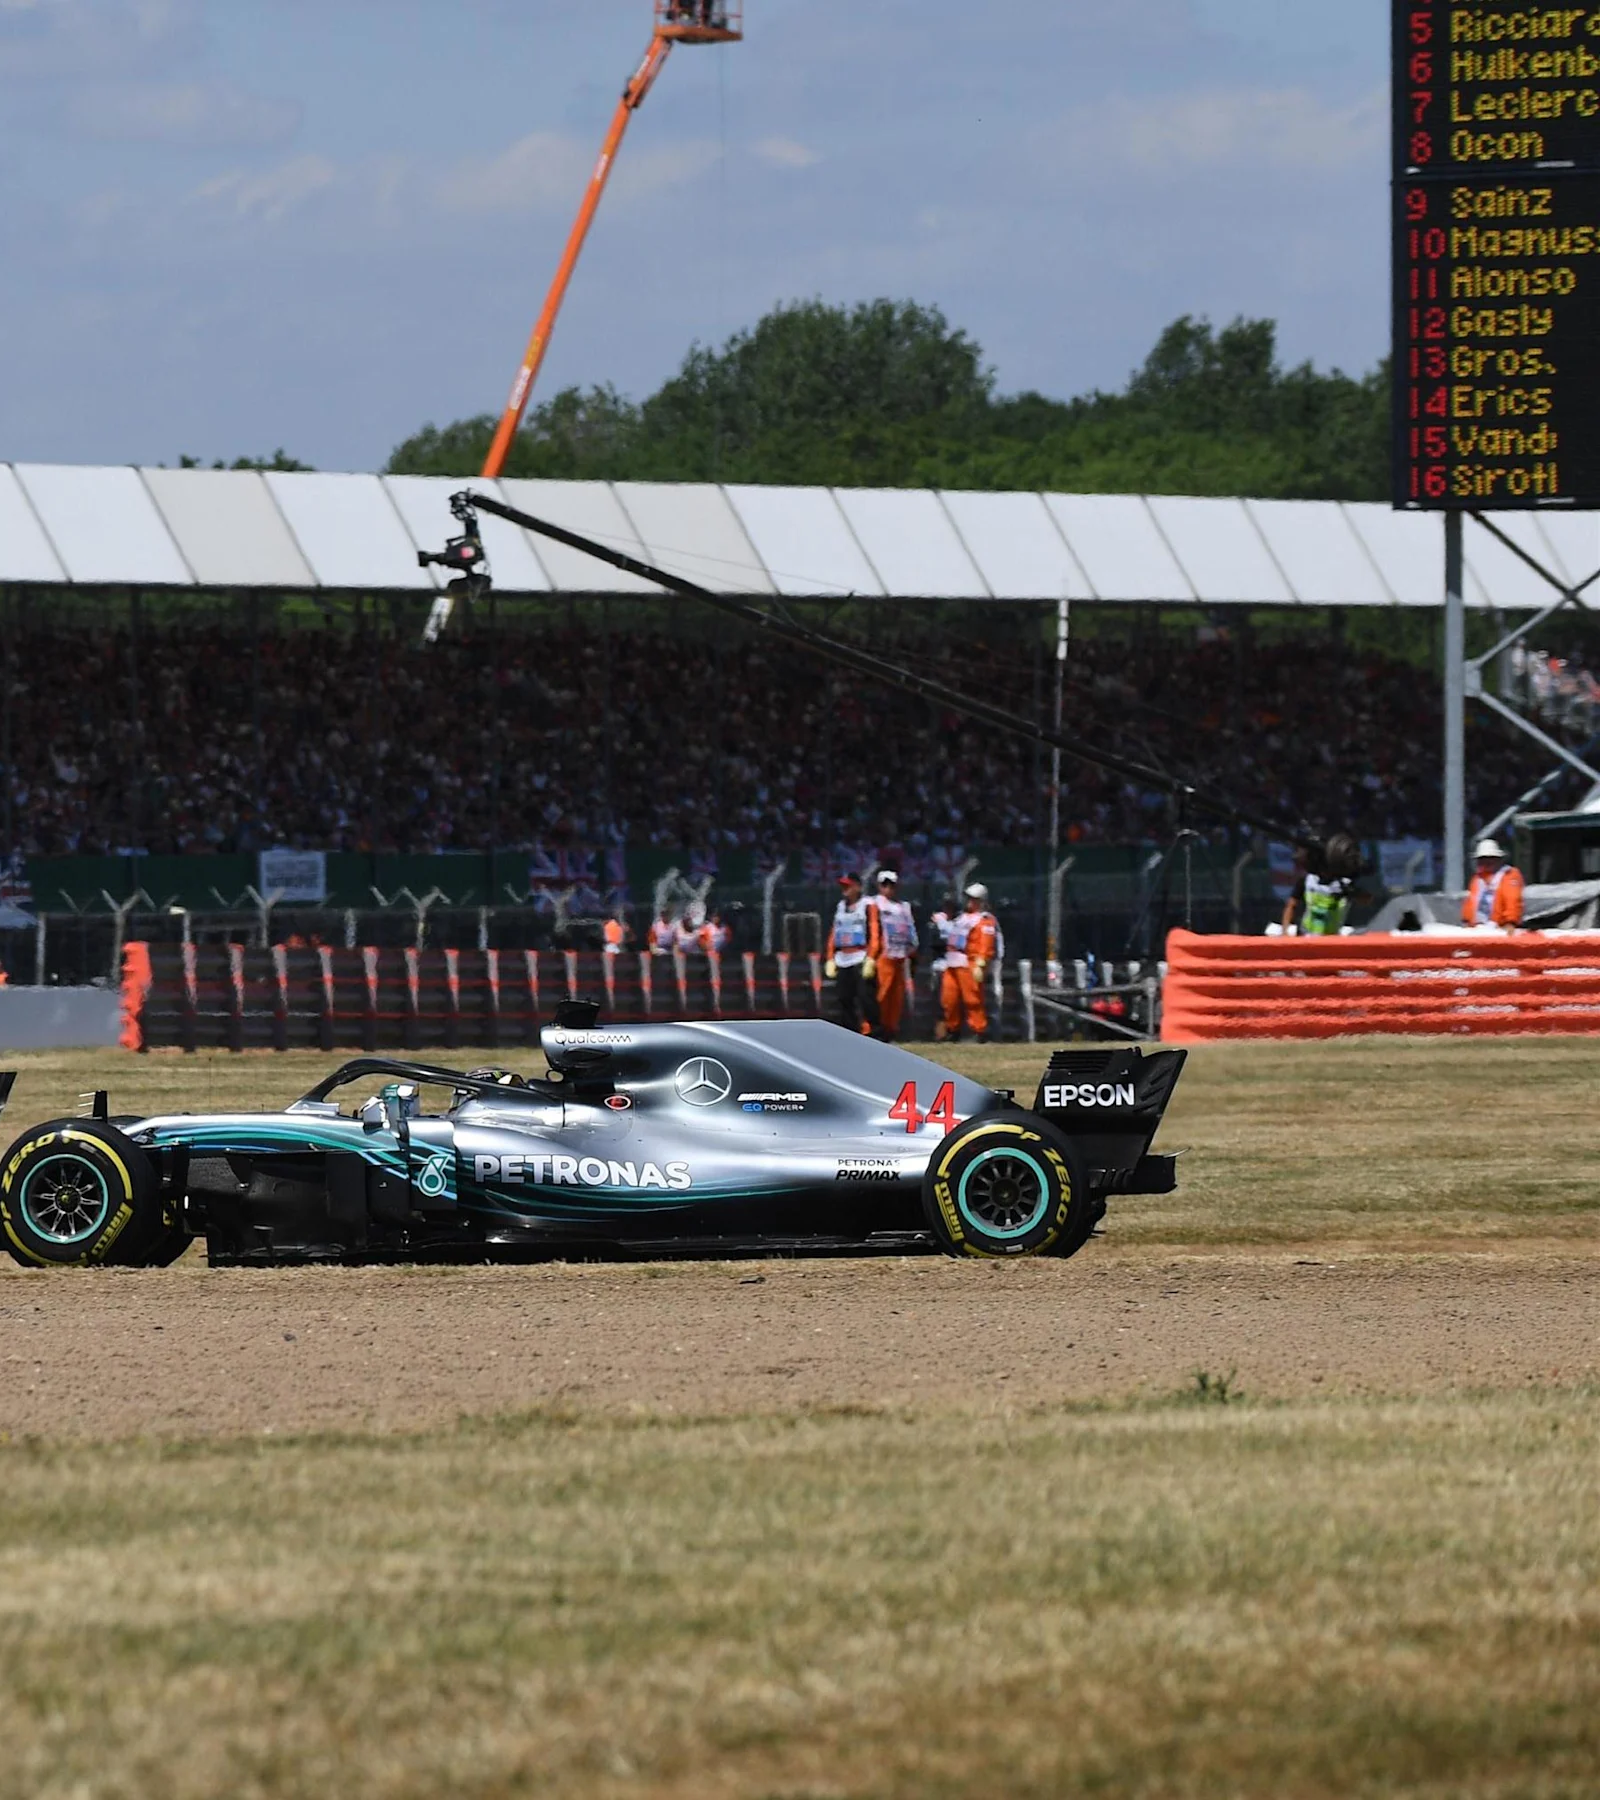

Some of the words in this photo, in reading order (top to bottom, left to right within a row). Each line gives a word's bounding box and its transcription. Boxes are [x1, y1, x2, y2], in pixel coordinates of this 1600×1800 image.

[1409, 12, 1433, 44] 5
[1409, 52, 1433, 83] 6
[1410, 91, 1432, 123] 7
[1451, 87, 1600, 122] Leclerc
[1410, 131, 1433, 163] 8
[1451, 129, 1543, 161] Ocon
[1405, 188, 1428, 220] 9
[1451, 185, 1552, 219] Sainz
[1408, 228, 1446, 259] 10
[1451, 226, 1600, 258] Magnus
[1410, 268, 1437, 299] 11
[1451, 265, 1577, 298] Alonso
[1410, 307, 1448, 339] 12
[1451, 303, 1553, 337] Gasly
[1410, 346, 1448, 378] 13
[1410, 386, 1448, 418] 14
[1451, 384, 1552, 417] Erics
[1410, 426, 1448, 458] 15
[1410, 465, 1447, 497] 16
[555, 1032, 632, 1046] Qualcomm
[760, 1093, 808, 1101] AMG
[888, 1081, 962, 1135] 44
[1044, 1083, 1135, 1108] EPSON
[2, 1131, 56, 1194] ZERO
[474, 1154, 692, 1190] PETRONAS
[835, 1169, 901, 1181] PRIMAX
